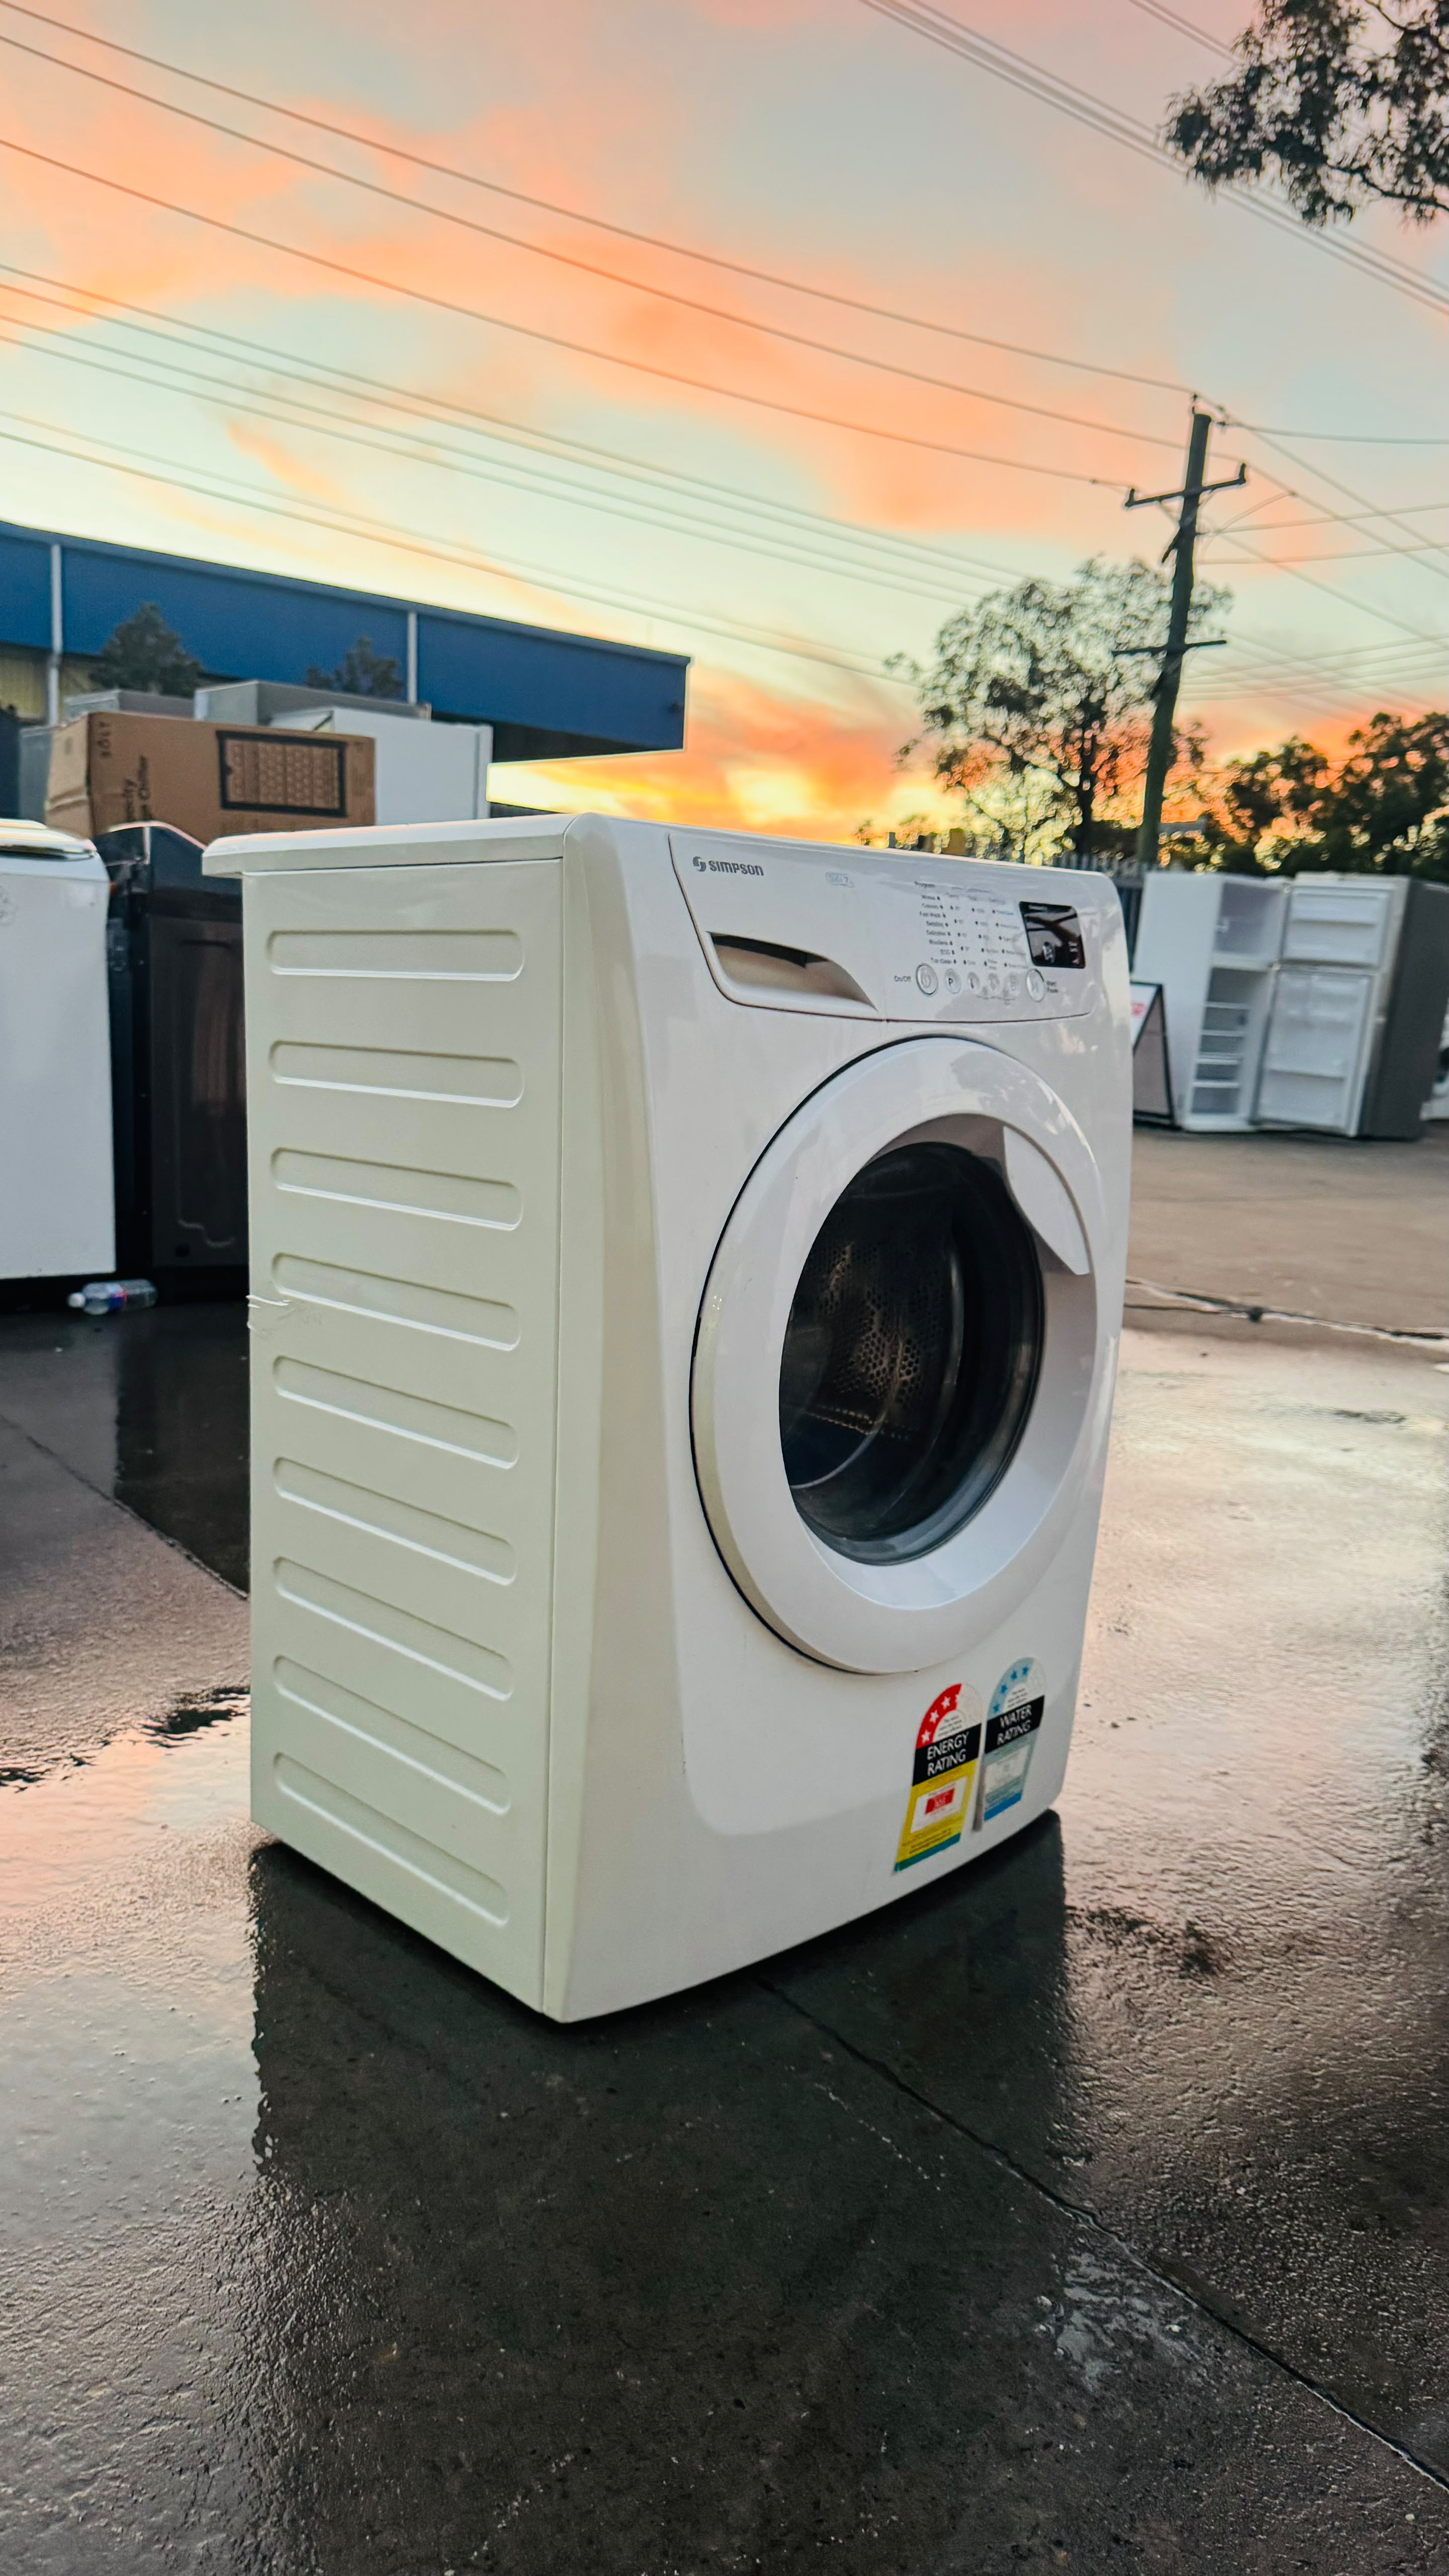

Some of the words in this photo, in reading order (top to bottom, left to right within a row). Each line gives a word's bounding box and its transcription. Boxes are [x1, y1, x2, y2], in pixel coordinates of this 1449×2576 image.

[708, 860, 764, 876] SIMPSON
[1000, 1704, 1032, 1727] WATER
[927, 1731, 969, 1760] ENERGY
[997, 1720, 1031, 1746] RATING
[927, 1748, 966, 1777] RATING
